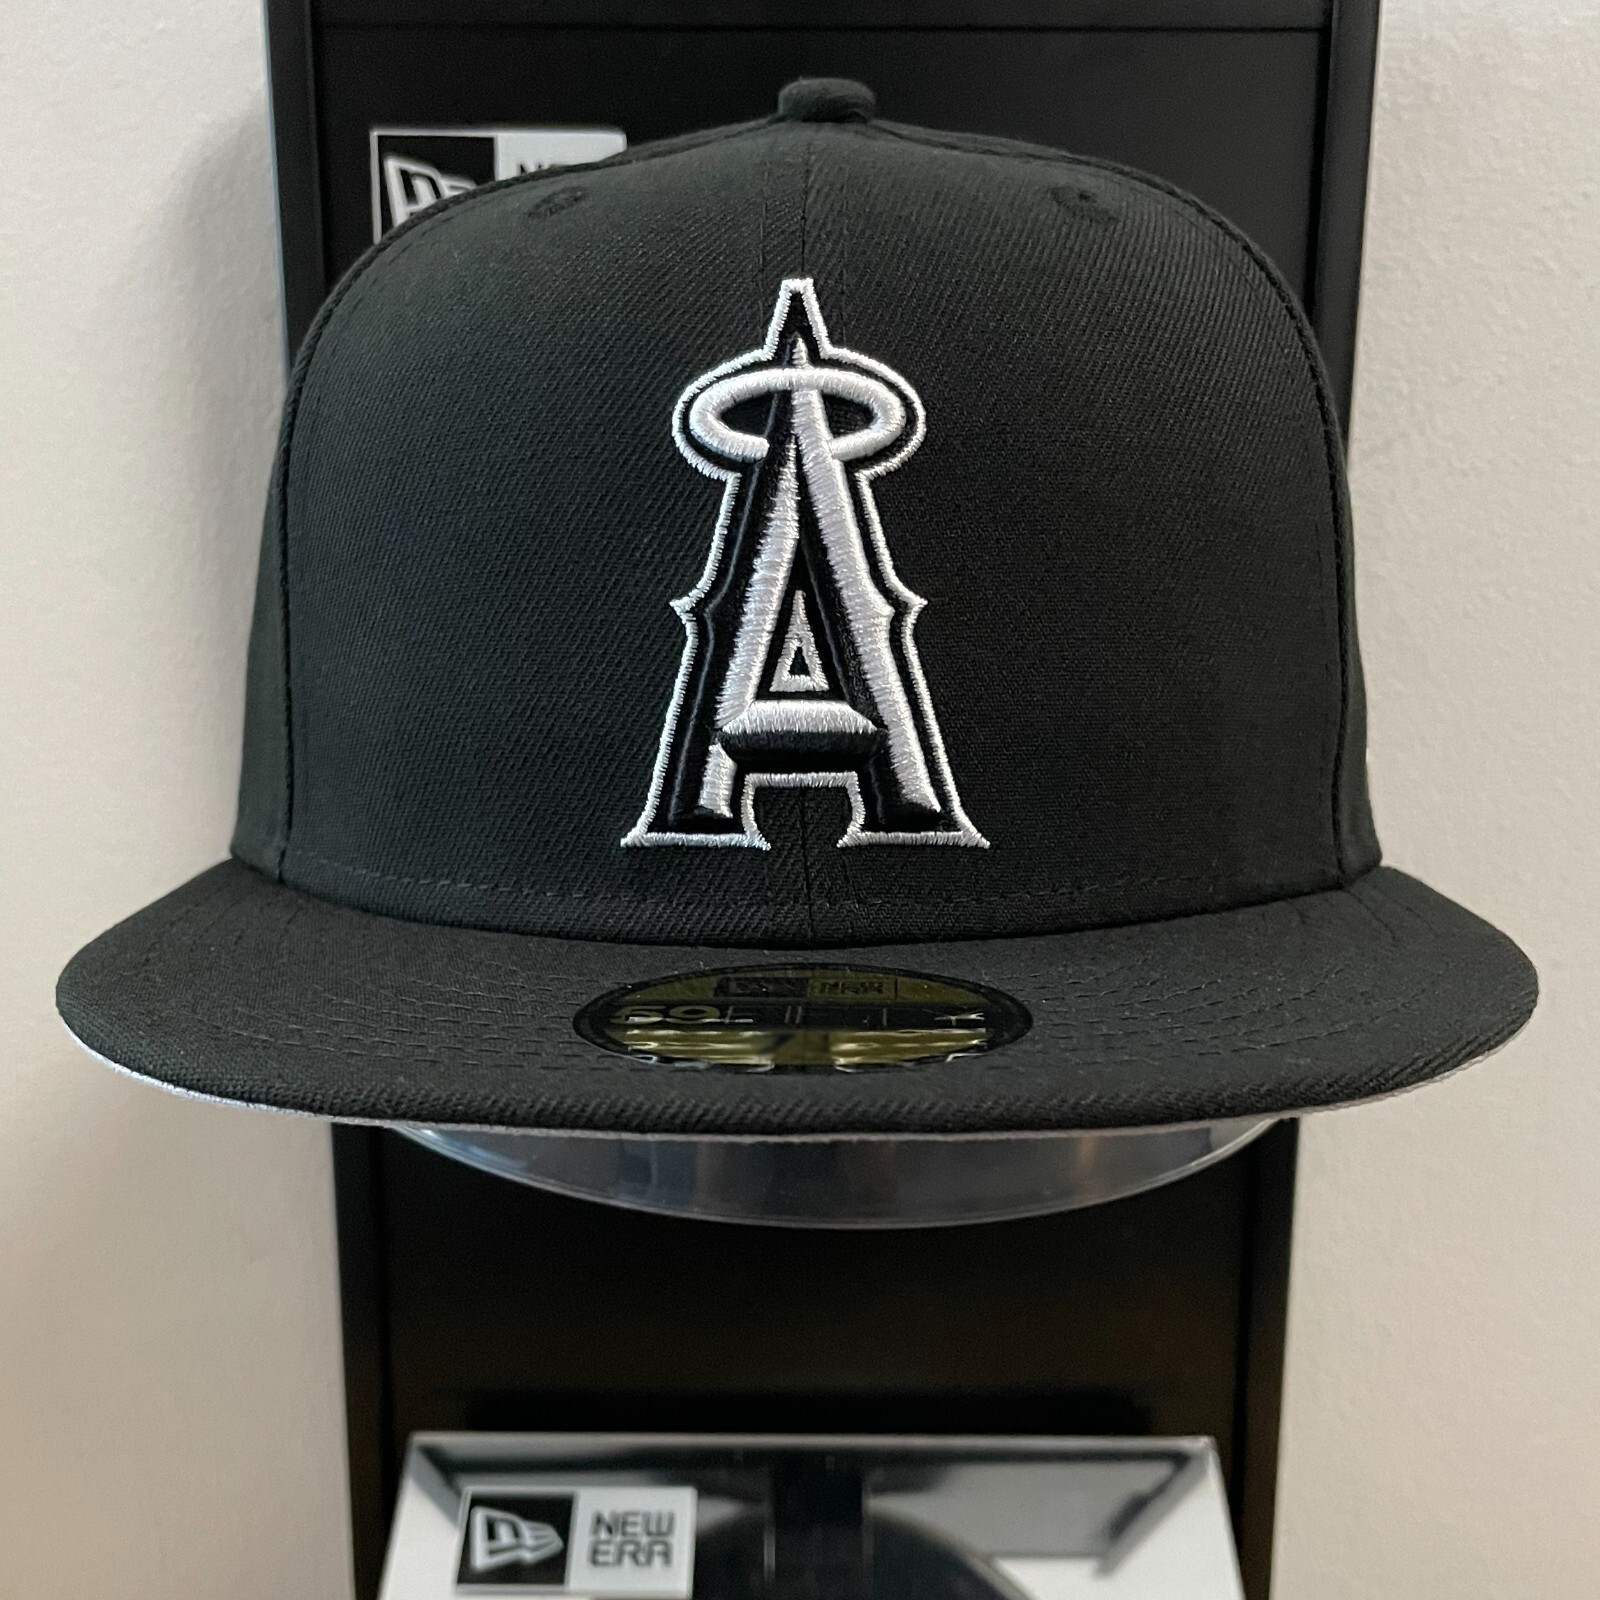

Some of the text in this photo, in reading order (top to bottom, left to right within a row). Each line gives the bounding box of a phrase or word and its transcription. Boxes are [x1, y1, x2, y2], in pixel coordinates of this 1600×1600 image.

[620, 277, 991, 850] A
[593, 1510, 675, 1537] NEW
[590, 1540, 673, 1567] ERA
